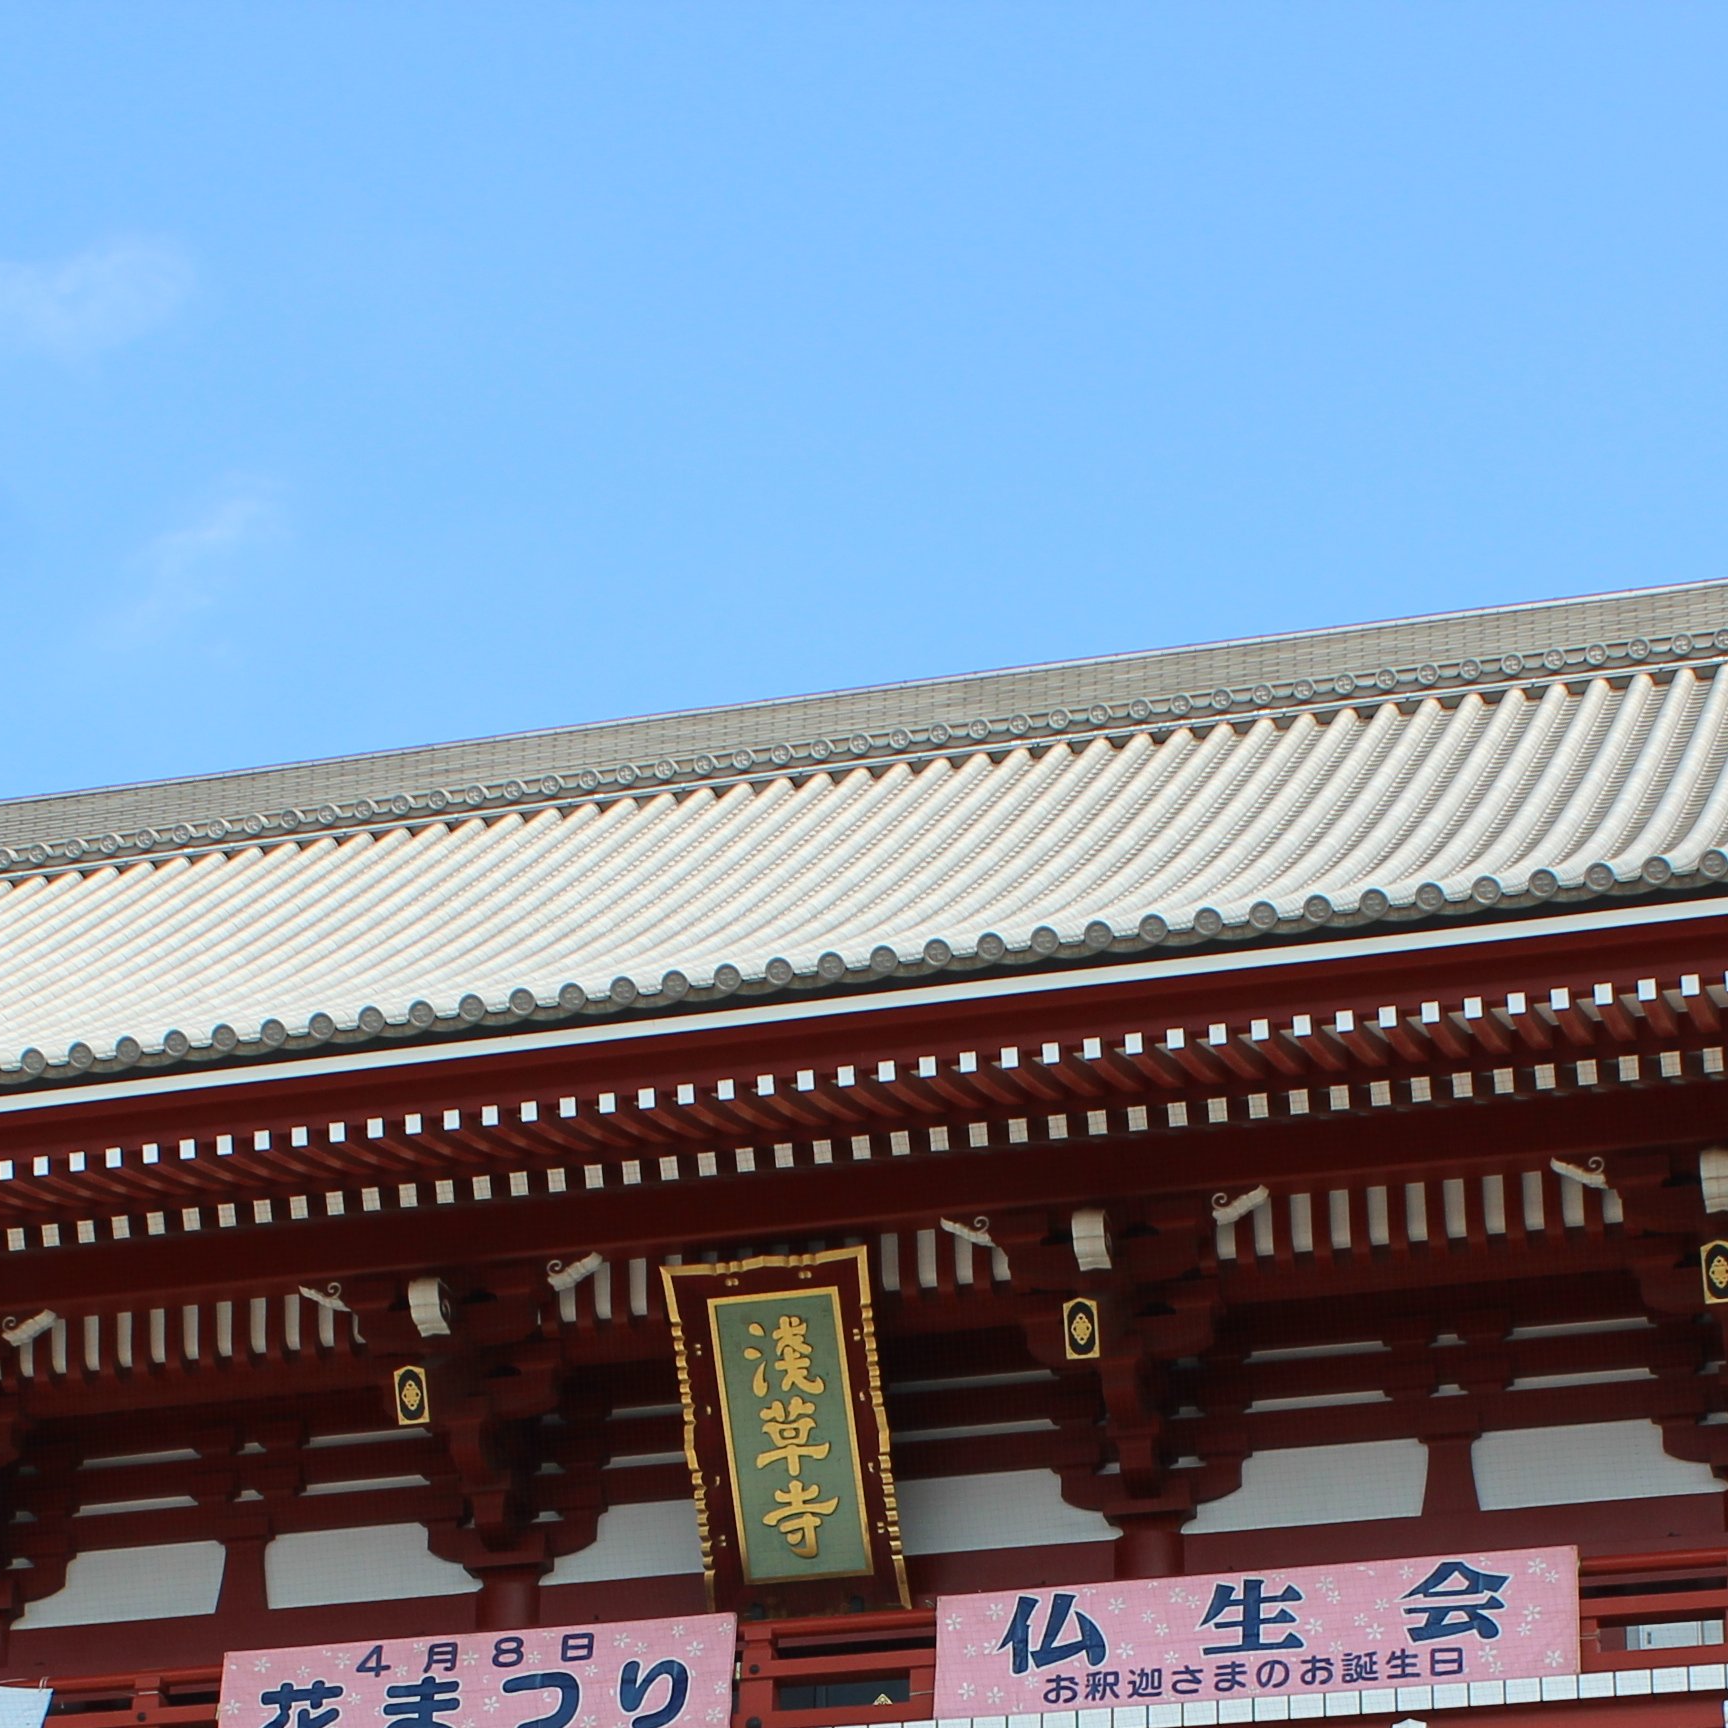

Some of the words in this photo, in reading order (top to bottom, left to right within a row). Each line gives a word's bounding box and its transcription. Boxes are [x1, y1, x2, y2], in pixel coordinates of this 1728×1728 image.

[995, 1559, 1512, 1675] 仏生会
[356, 1632, 596, 1678] 4月8日
[1042, 1647, 1465, 1704] お釈迦さまのお誕生日
